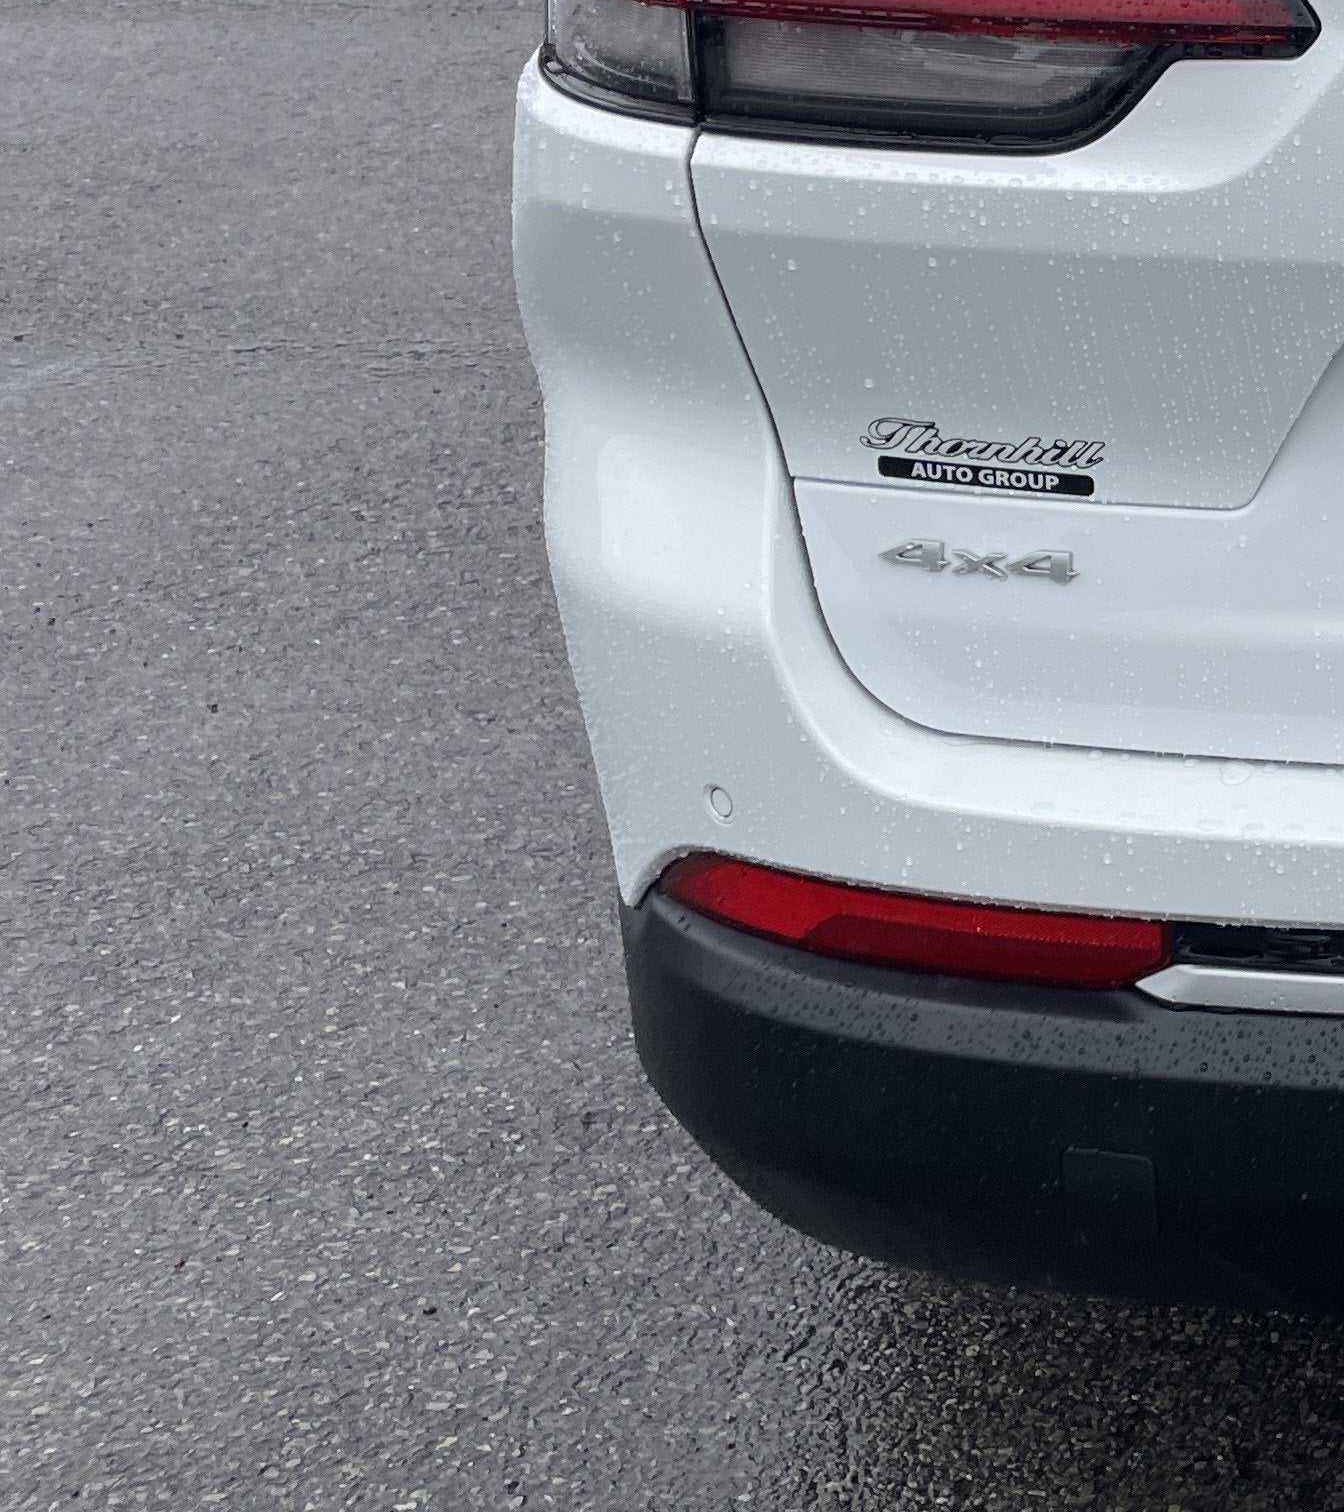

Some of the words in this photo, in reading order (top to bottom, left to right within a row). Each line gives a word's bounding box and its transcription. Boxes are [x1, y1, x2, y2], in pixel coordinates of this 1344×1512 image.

[859, 416, 1106, 470] Thornhill
[910, 462, 974, 484] AUTO
[978, 468, 1060, 491] GROUP
